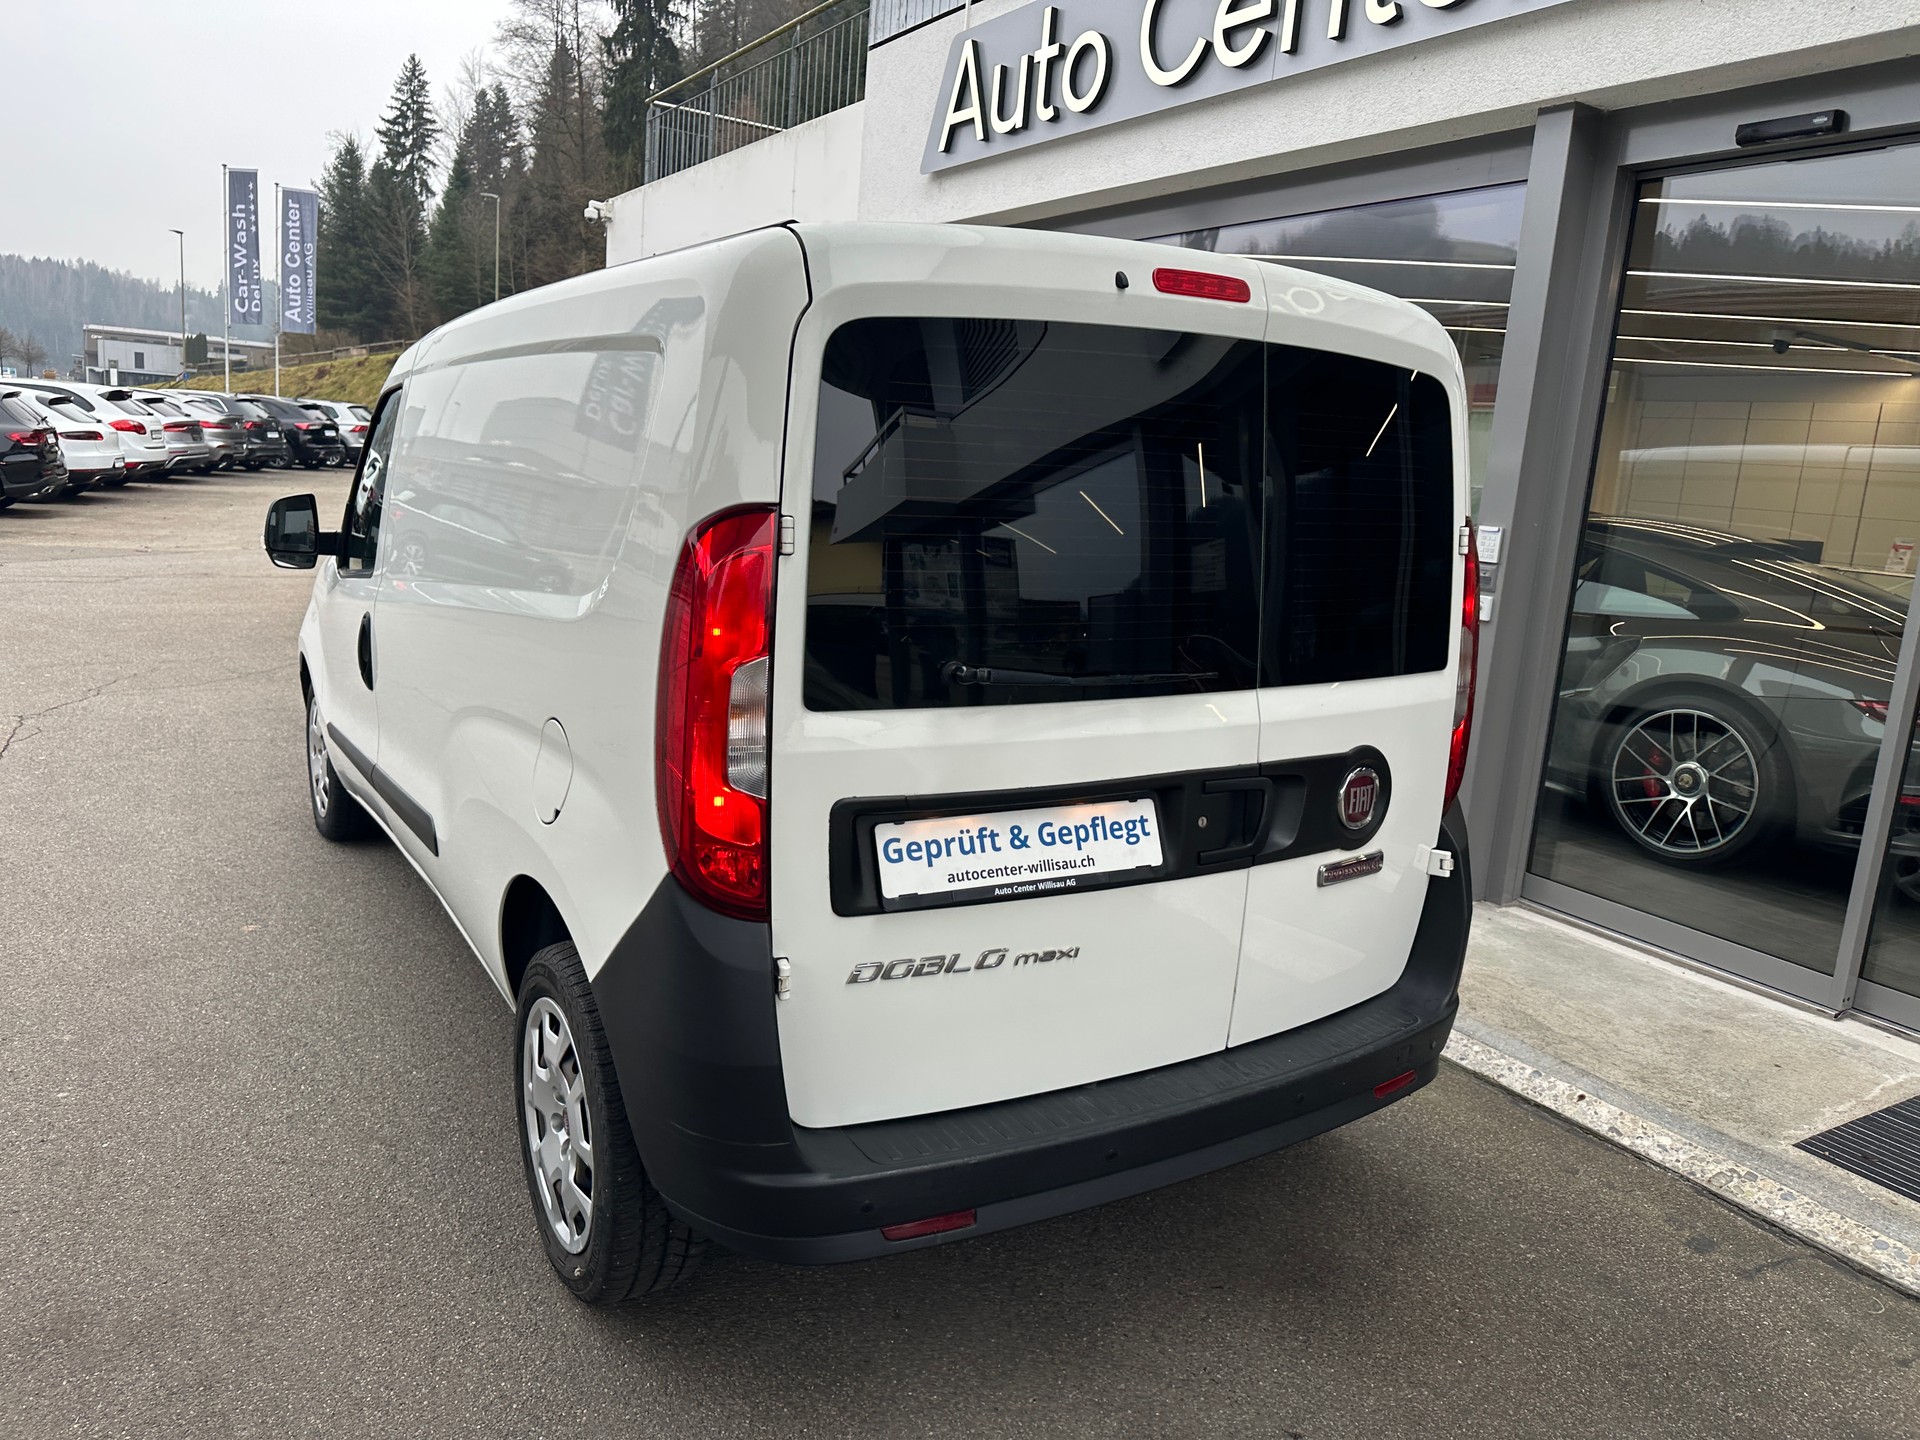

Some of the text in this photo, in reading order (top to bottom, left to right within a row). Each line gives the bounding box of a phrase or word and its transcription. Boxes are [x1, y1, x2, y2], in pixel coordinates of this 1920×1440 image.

[938, 6, 1111, 152] Auto
[232, 204, 249, 313] Car-Wash
[285, 199, 302, 323] Auto Center
[303, 243, 314, 324] Willisau AG
[1348, 784, 1374, 815] FIAT
[882, 814, 1151, 868] Geprüft & Gepflegt
[947, 855, 1096, 883] autocenter-willisau.ch
[994, 878, 1076, 896] Auto Center Willisau AG
